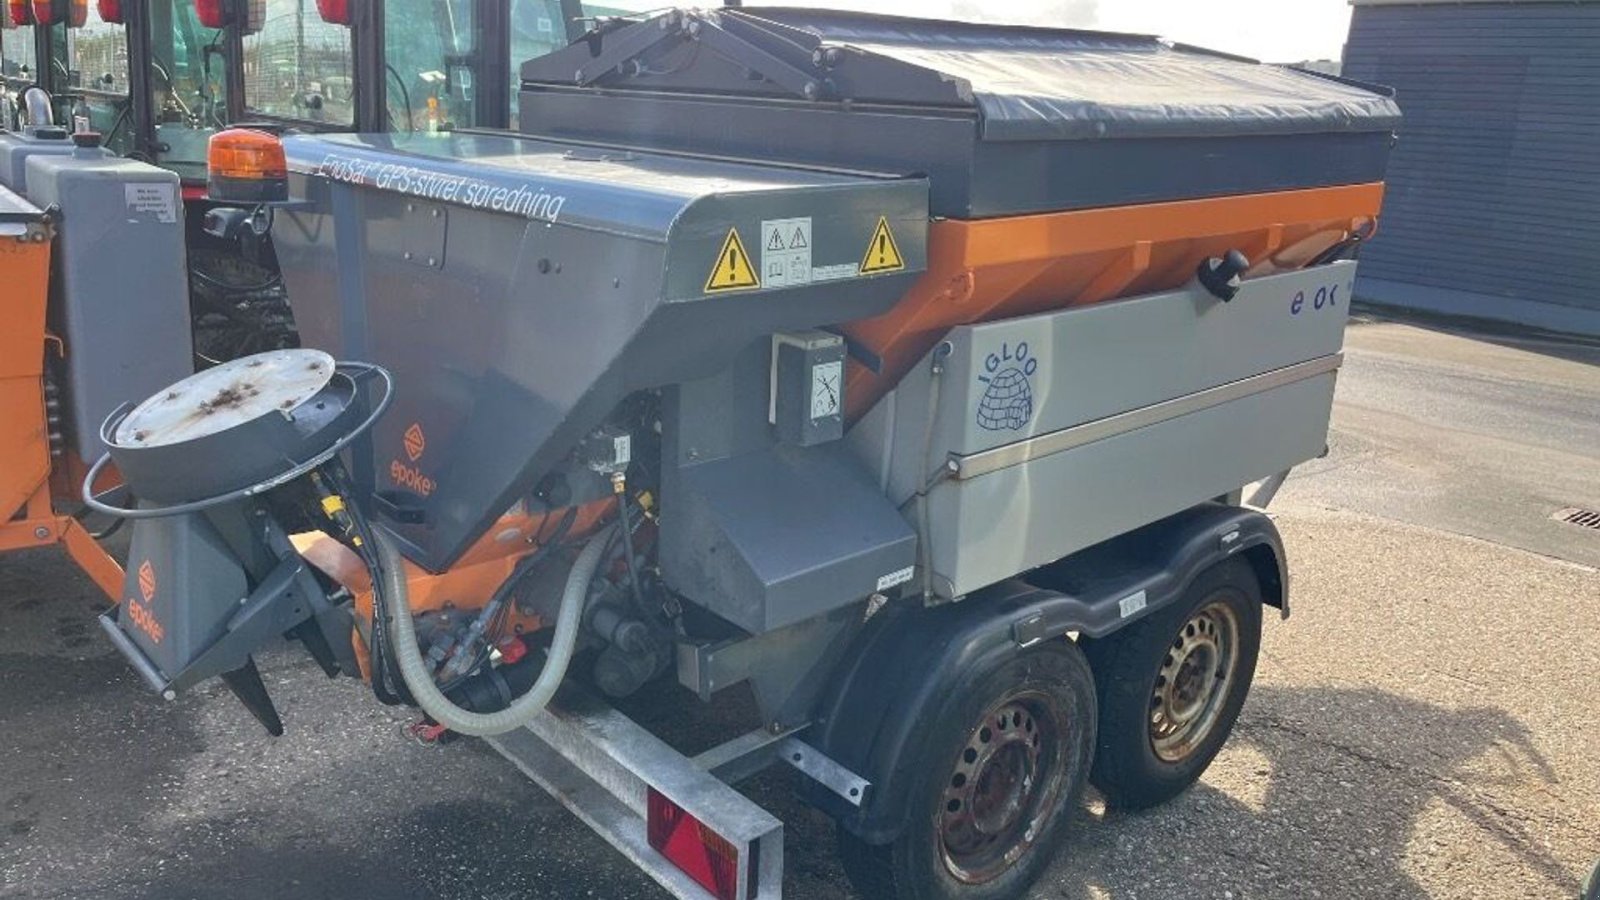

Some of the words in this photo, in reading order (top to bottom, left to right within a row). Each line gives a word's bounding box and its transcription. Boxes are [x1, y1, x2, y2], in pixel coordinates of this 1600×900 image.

[463, 183, 566, 223] spredning
[978, 342, 1037, 383] IGLOO
[391, 460, 433, 496] epoke
